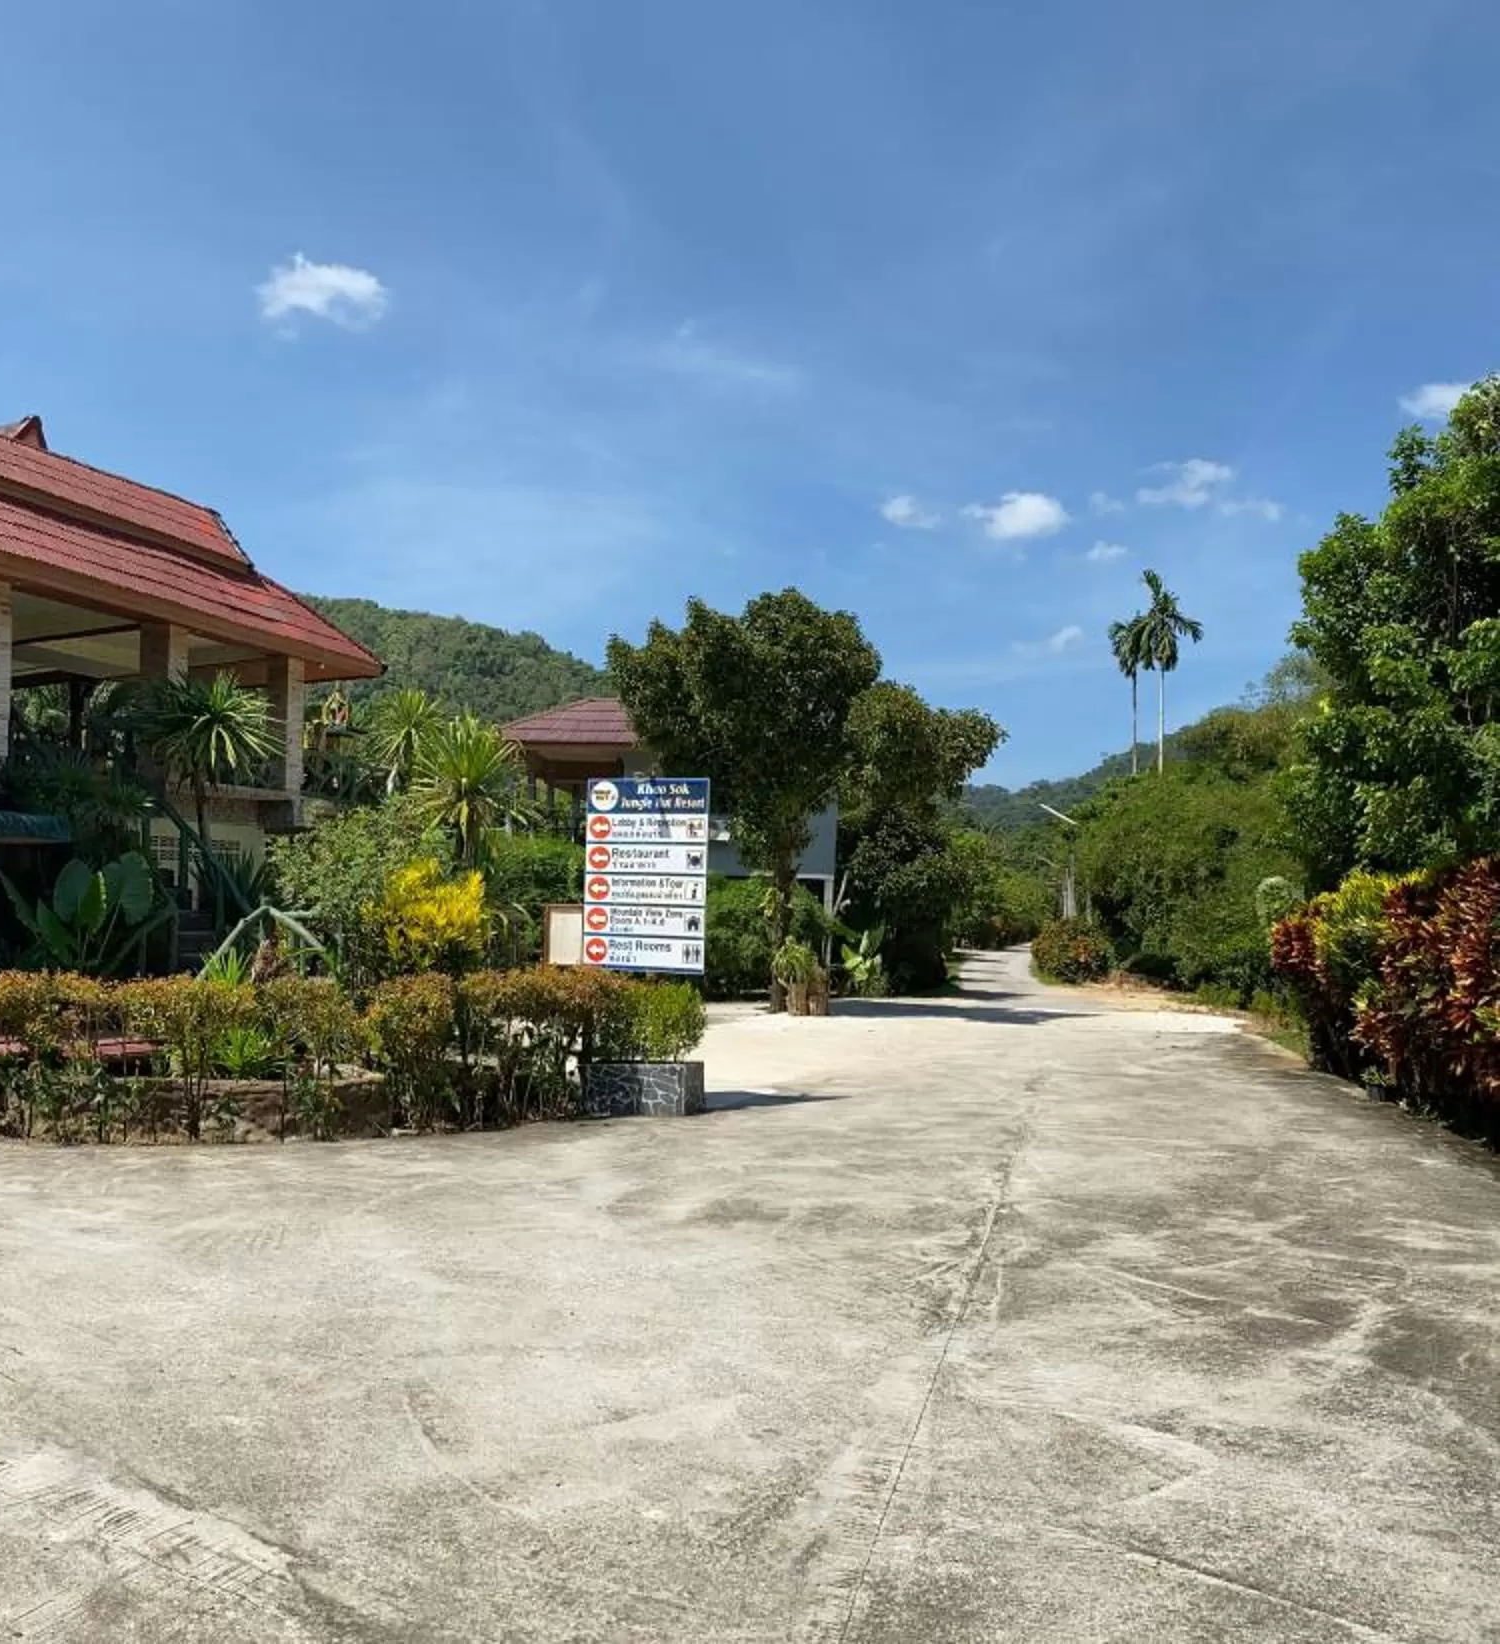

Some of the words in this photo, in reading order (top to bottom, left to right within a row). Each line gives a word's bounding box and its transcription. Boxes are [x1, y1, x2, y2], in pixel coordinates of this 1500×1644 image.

[669, 783, 690, 795] Sok
[621, 797, 653, 810] Jungle
[674, 797, 705, 809] Resort
[612, 818, 637, 829] Lobby
[639, 818, 645, 827] &
[612, 848, 669, 859] Restaurant
[611, 878, 657, 887] Information
[610, 908, 643, 917] Mountain
[645, 908, 663, 917] View
[609, 940, 633, 951] Rest
[635, 939, 672, 953] Rooms
